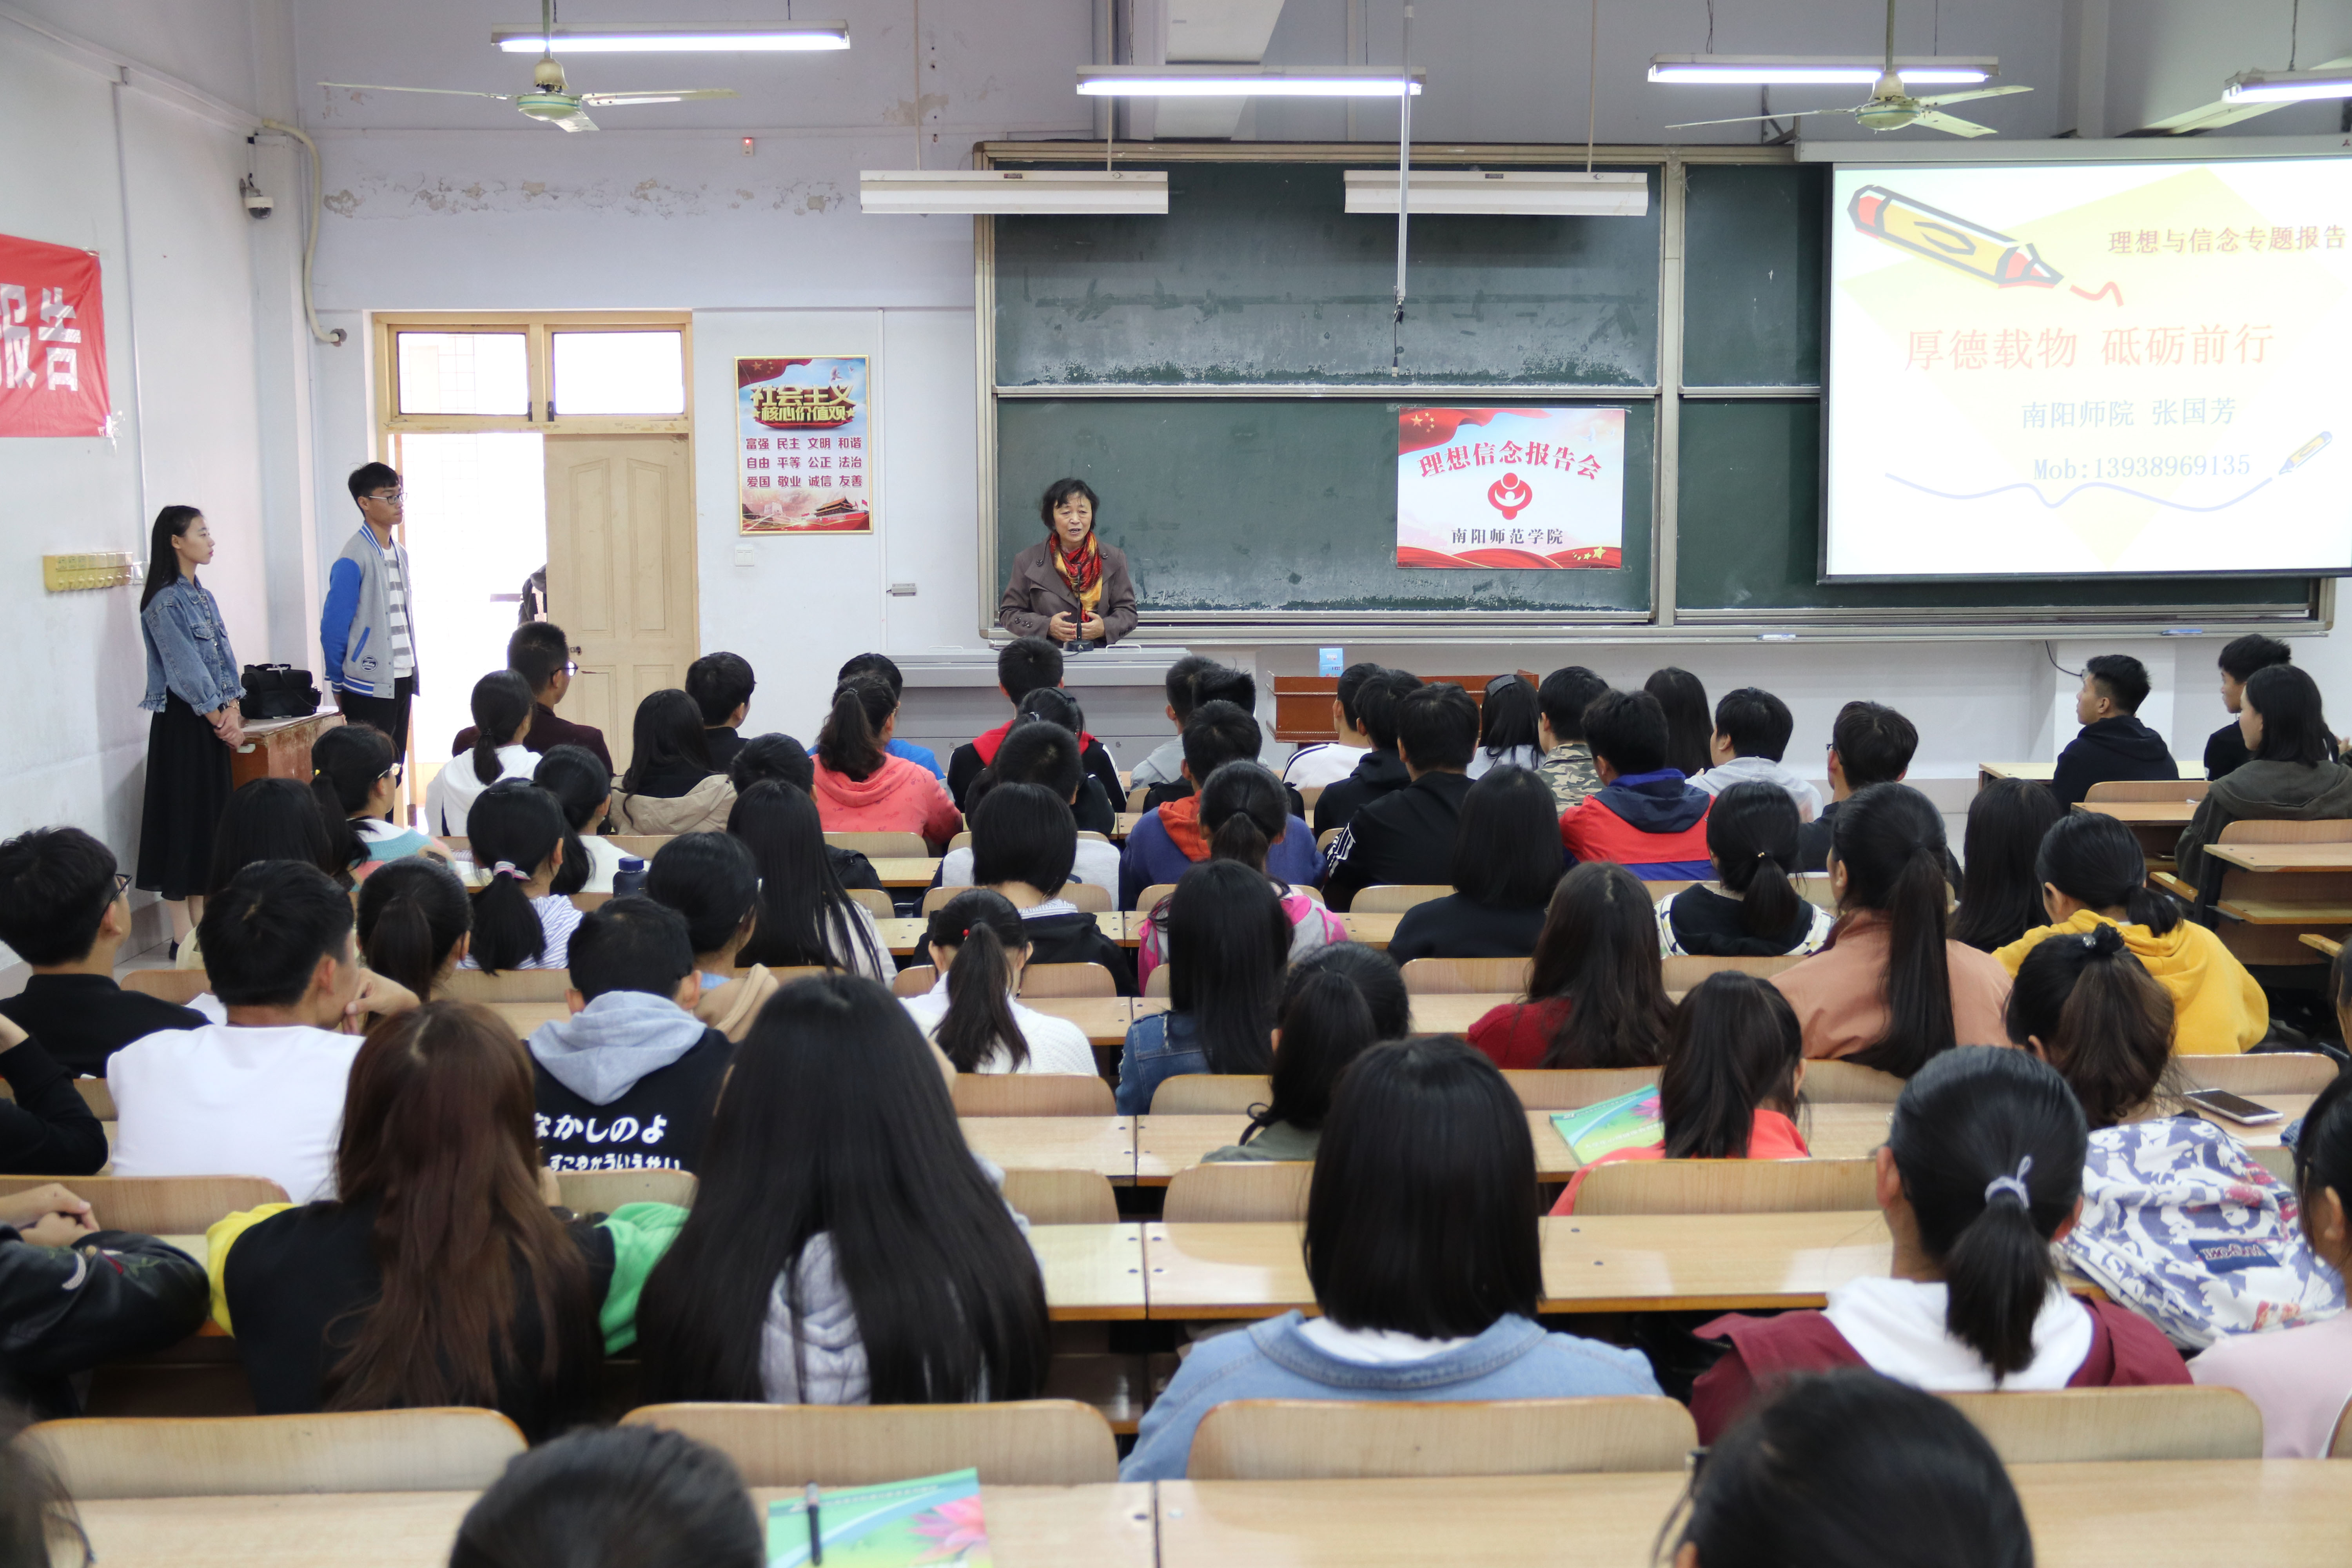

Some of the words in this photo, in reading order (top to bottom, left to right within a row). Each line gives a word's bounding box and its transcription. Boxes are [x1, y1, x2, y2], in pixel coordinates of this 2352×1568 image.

[2108, 225, 2347, 254] 理想与信念专题报告
[1904, 327, 2078, 372] 厚德载物
[2100, 323, 2274, 366] 砥砺前行
[750, 384, 857, 407] 社会主义
[761, 405, 846, 421] 核心价值观
[2021, 400, 2134, 429] 南阳师院
[2152, 397, 2236, 426] 张国芳
[746, 438, 769, 450] 富强
[777, 437, 800, 450] 民主
[808, 437, 831, 449] 文明
[838, 437, 861, 449] 和谐
[747, 457, 769, 469] 自由
[777, 457, 800, 468] 平等
[808, 457, 831, 468] 公正
[839, 456, 862, 468] 法治
[1416, 440, 1602, 480] 理想信念报告会
[2033, 454, 2250, 480] Mob:13938969135
[747, 476, 770, 488] 爱国
[778, 475, 801, 488] 敬业
[808, 475, 832, 487] 诚信
[839, 475, 862, 487] 友善
[1451, 528, 1563, 545] 南阳师范学院
